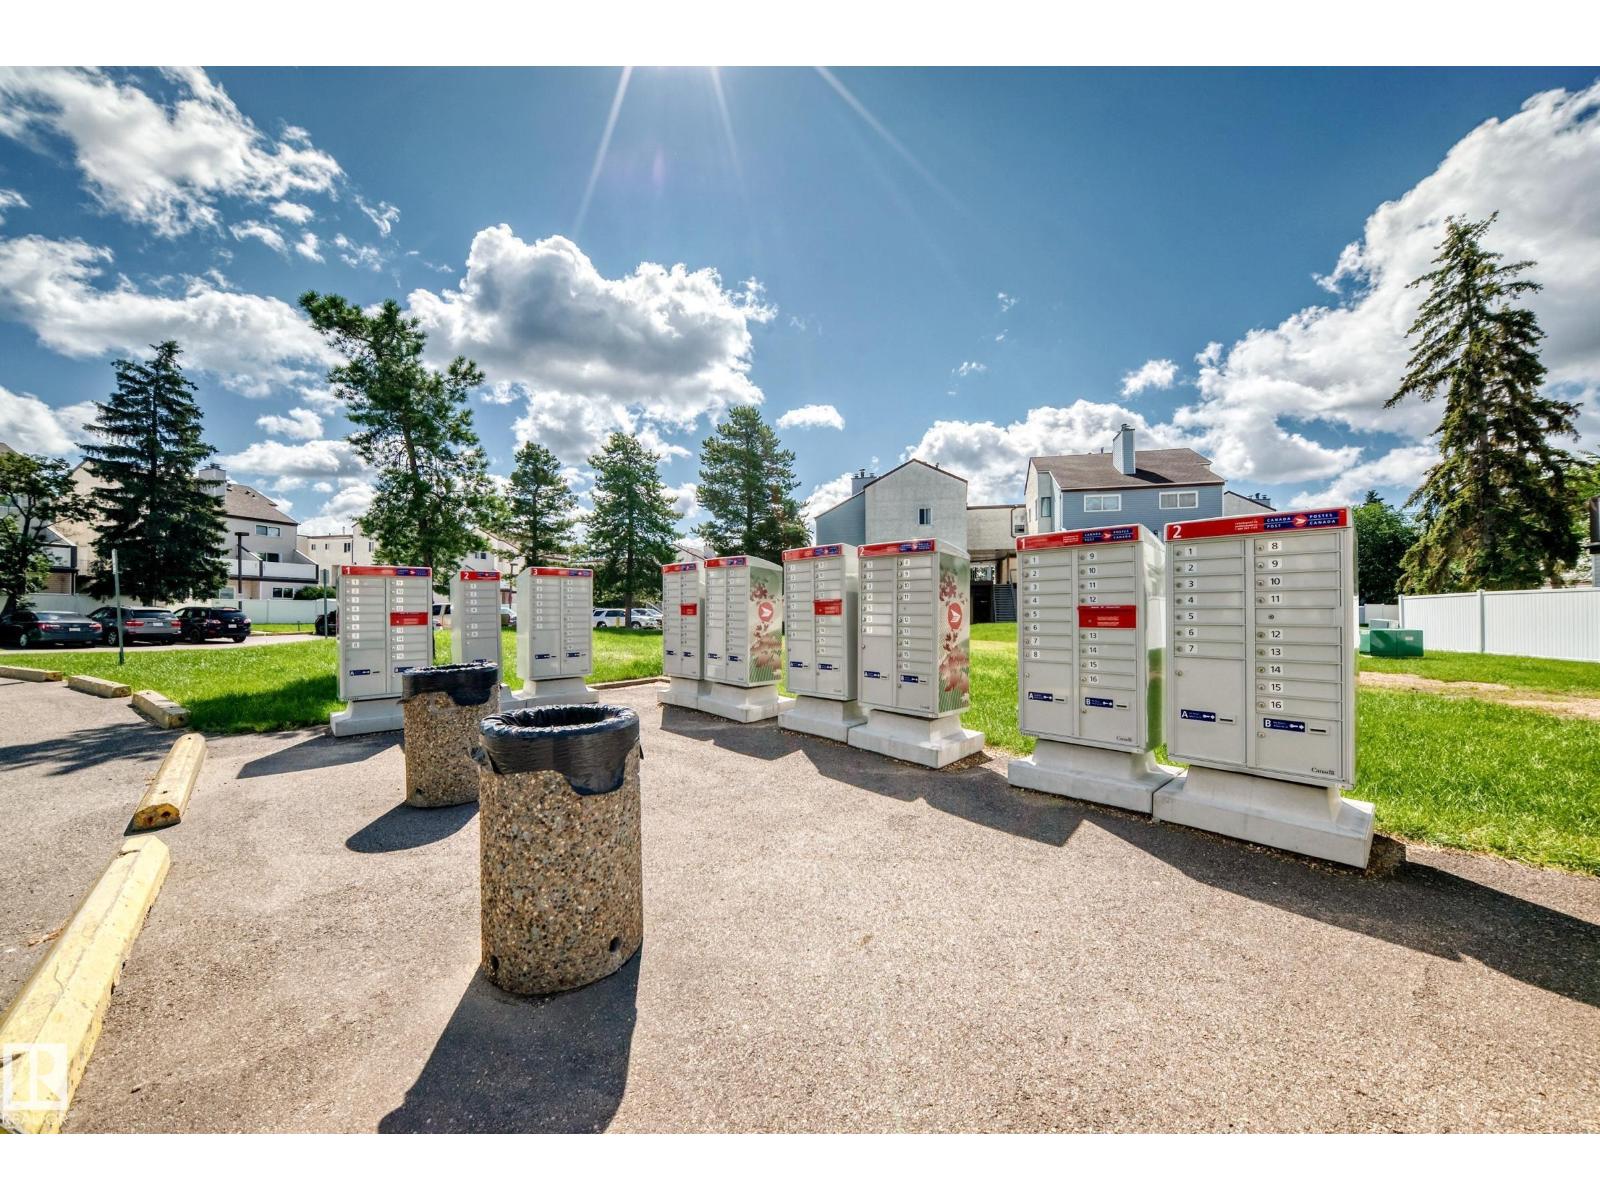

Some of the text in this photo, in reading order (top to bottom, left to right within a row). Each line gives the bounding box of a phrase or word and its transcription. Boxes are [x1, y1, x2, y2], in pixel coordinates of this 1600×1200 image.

[1173, 526, 1182, 538] 2
[1021, 539, 1025, 549] 1
[1271, 648, 1281, 656] 13
[1271, 701, 1281, 709] 16
[1181, 710, 1188, 718] A
[1265, 720, 1271, 728] B
